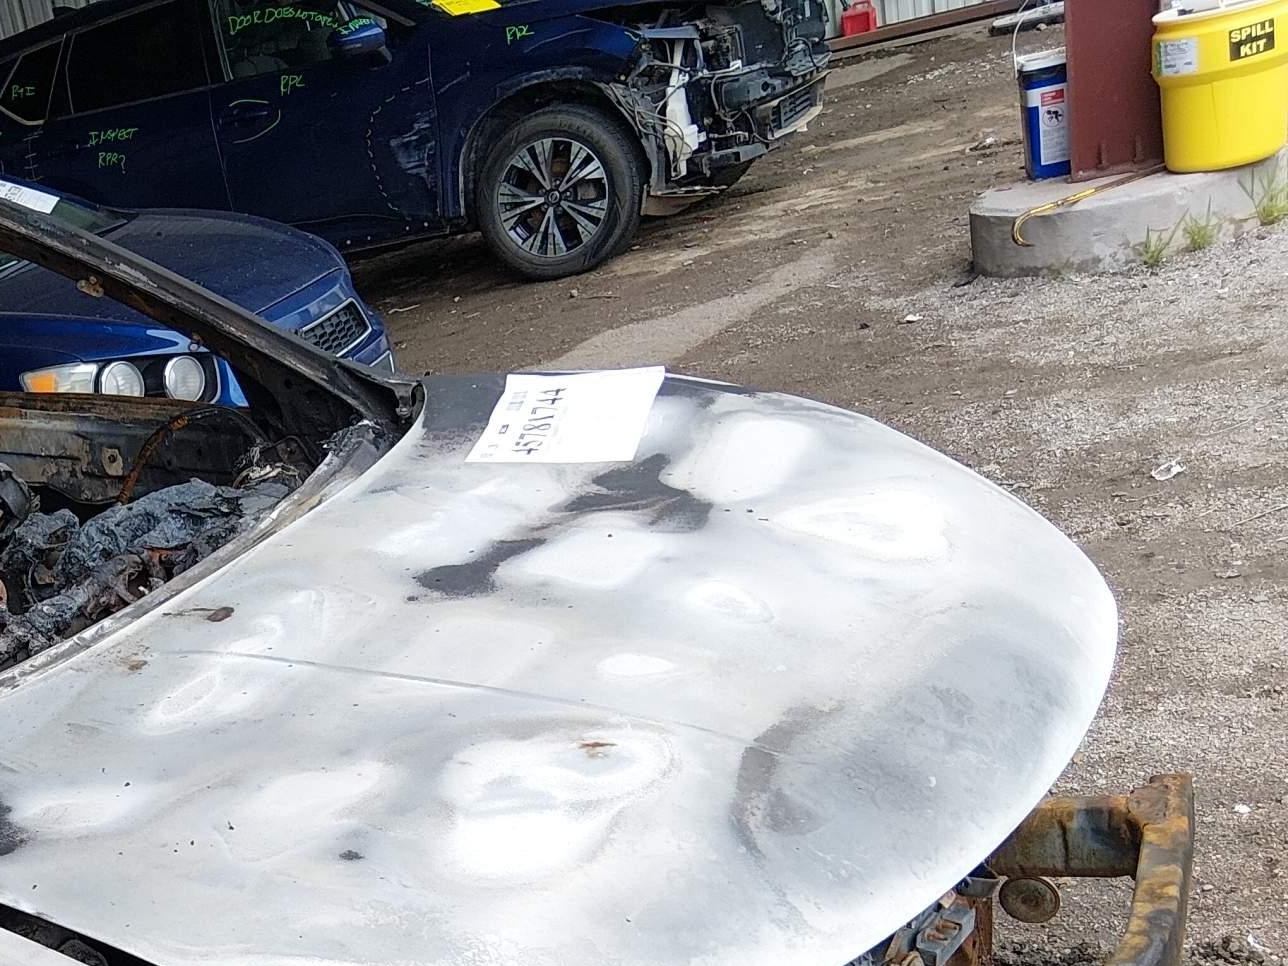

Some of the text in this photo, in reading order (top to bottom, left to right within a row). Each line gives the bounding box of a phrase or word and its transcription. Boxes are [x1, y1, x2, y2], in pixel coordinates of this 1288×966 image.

[228, 10, 263, 33] DOOR
[264, 7, 295, 23] DOES
[1230, 21, 1274, 43] SPILL
[1240, 39, 1267, 57] KIT
[88, 128, 139, 146] INSPECT
[512, 387, 567, 455] 45781744
